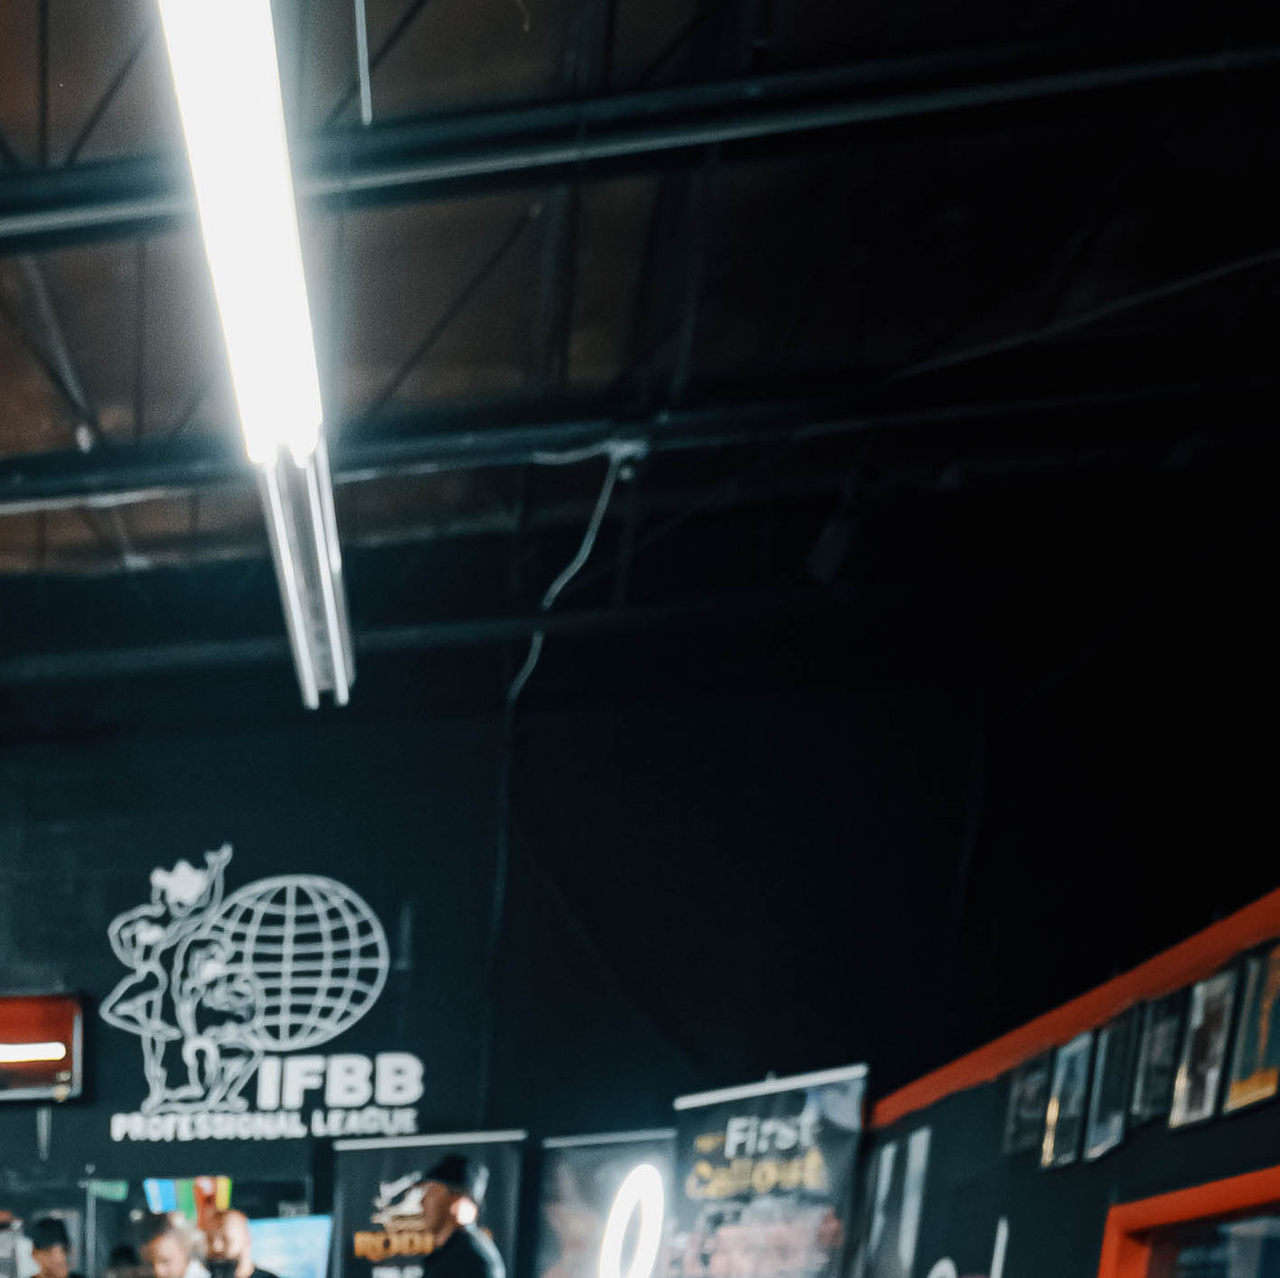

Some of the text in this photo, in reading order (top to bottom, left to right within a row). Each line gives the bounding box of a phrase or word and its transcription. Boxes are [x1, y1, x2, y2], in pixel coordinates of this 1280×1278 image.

[256, 1053, 425, 1111] IFBB
[110, 1106, 419, 1142] PROFESSIONAL LEAGUE
